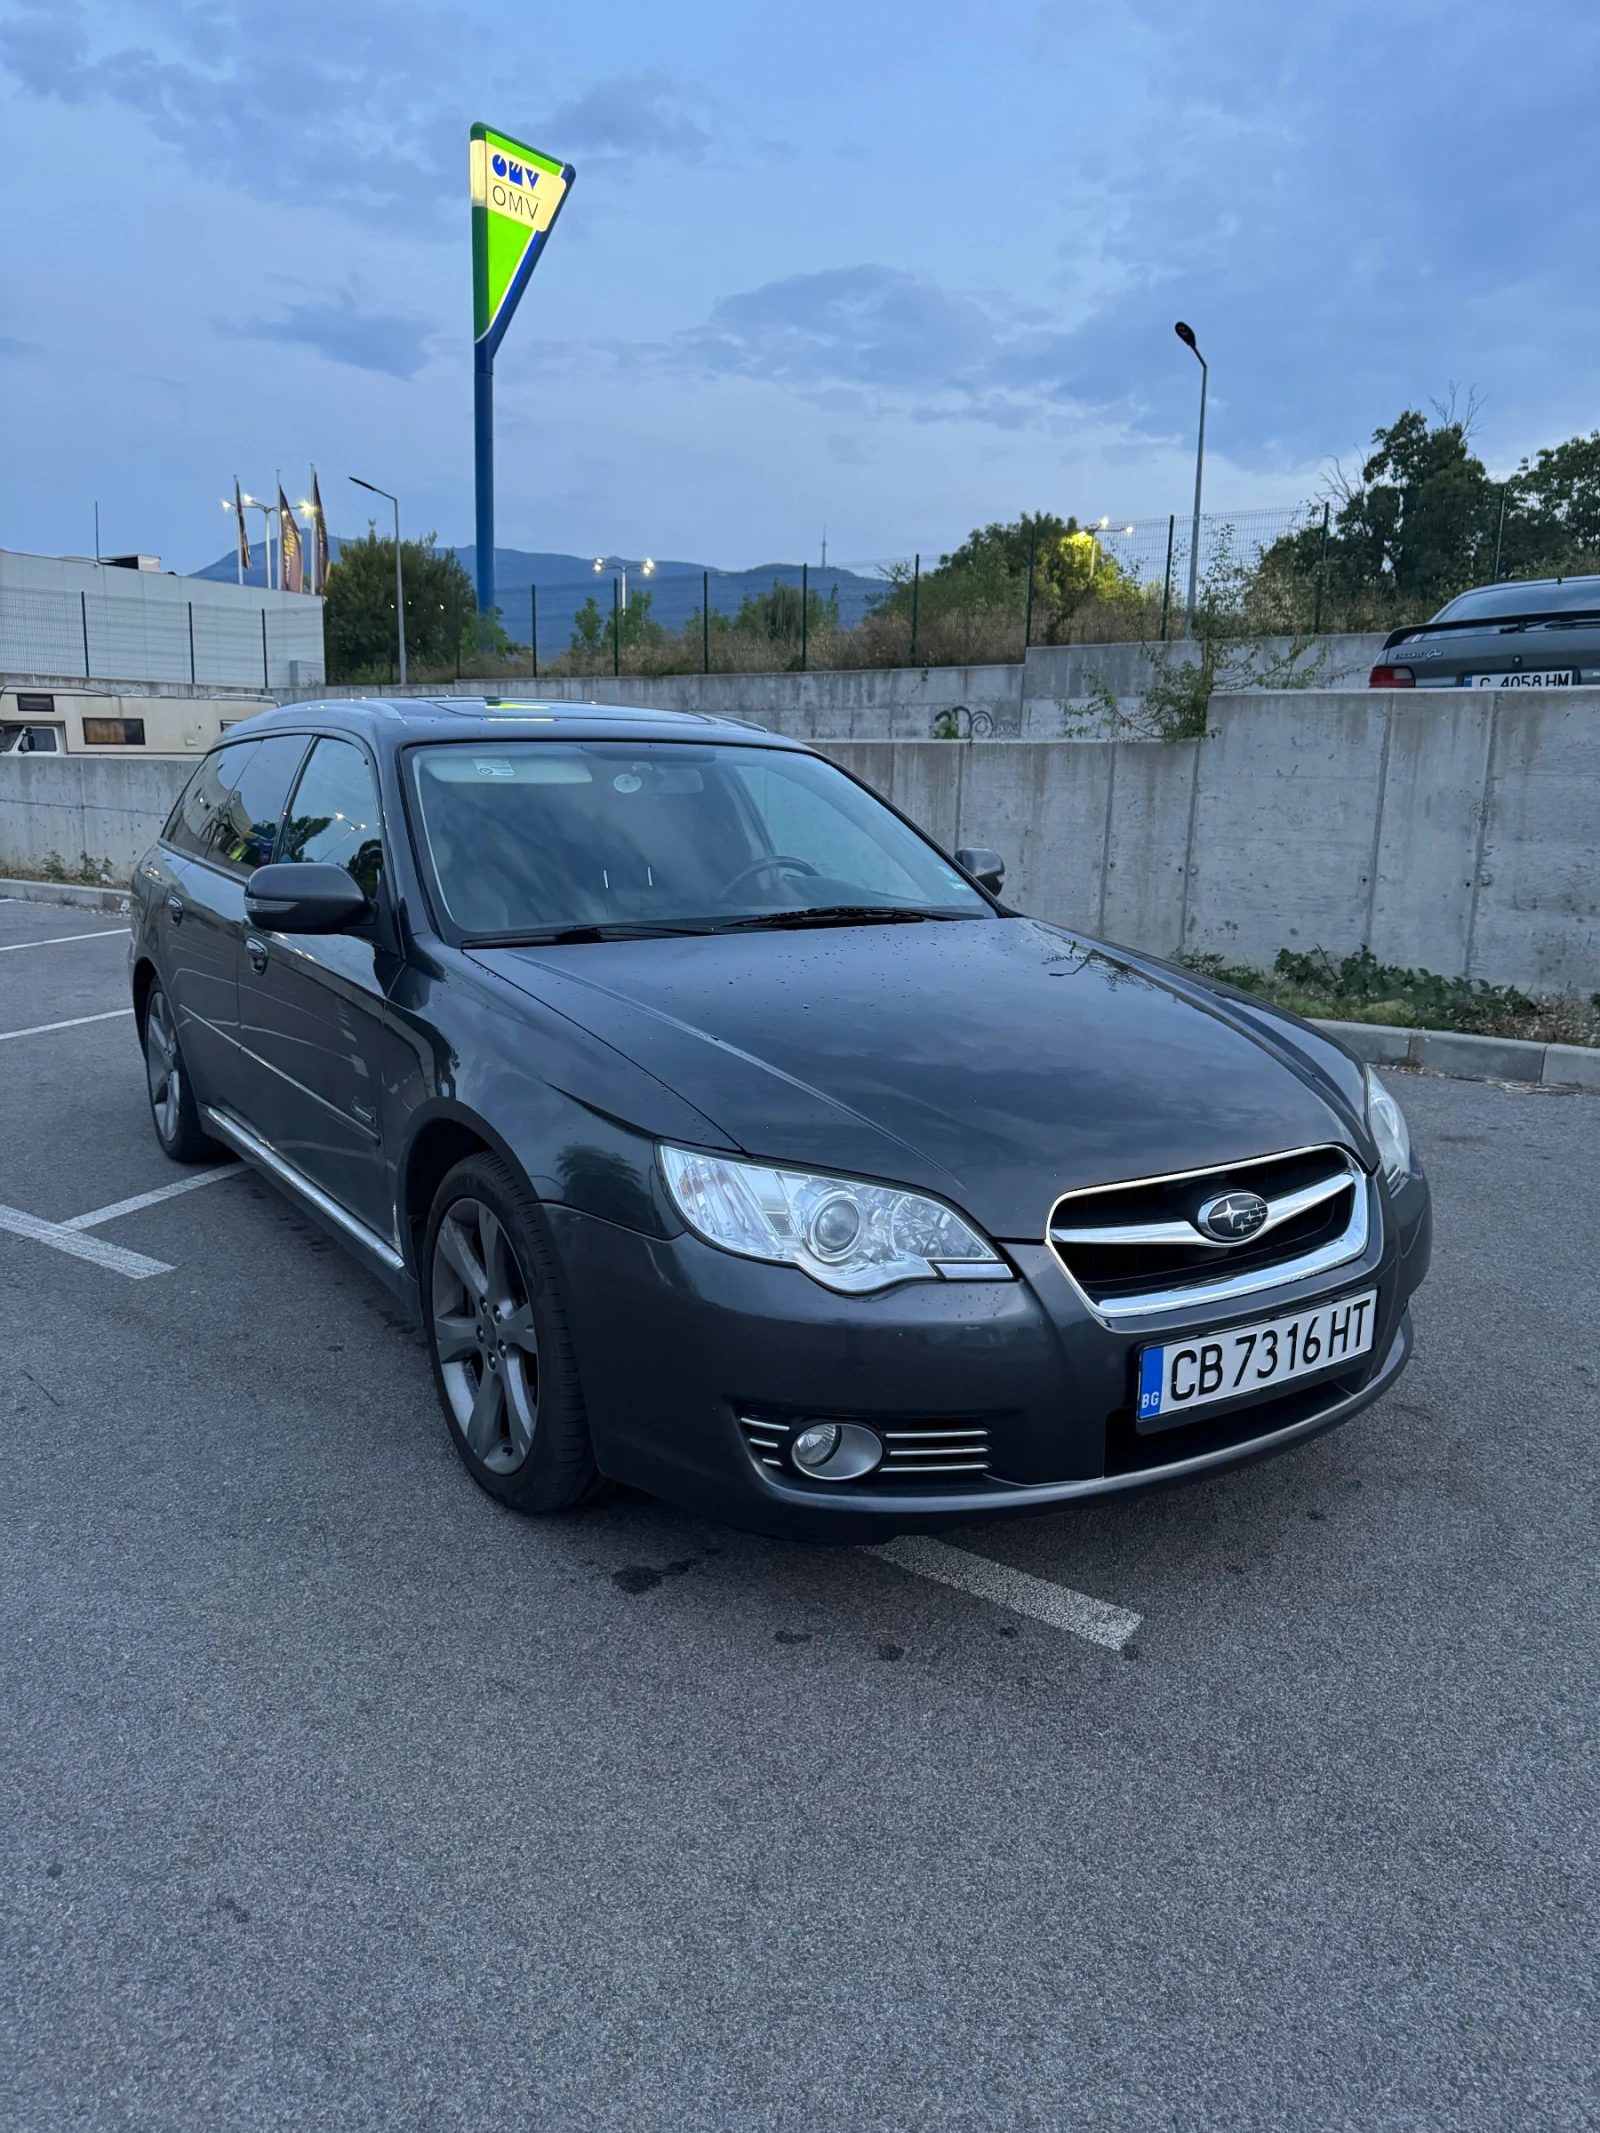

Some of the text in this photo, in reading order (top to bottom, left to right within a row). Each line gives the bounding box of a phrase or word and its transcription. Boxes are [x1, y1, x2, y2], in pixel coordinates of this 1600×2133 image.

[492, 154, 540, 190] OMV
[492, 185, 539, 220] OMV
[1141, 1391, 1160, 1409] BG
